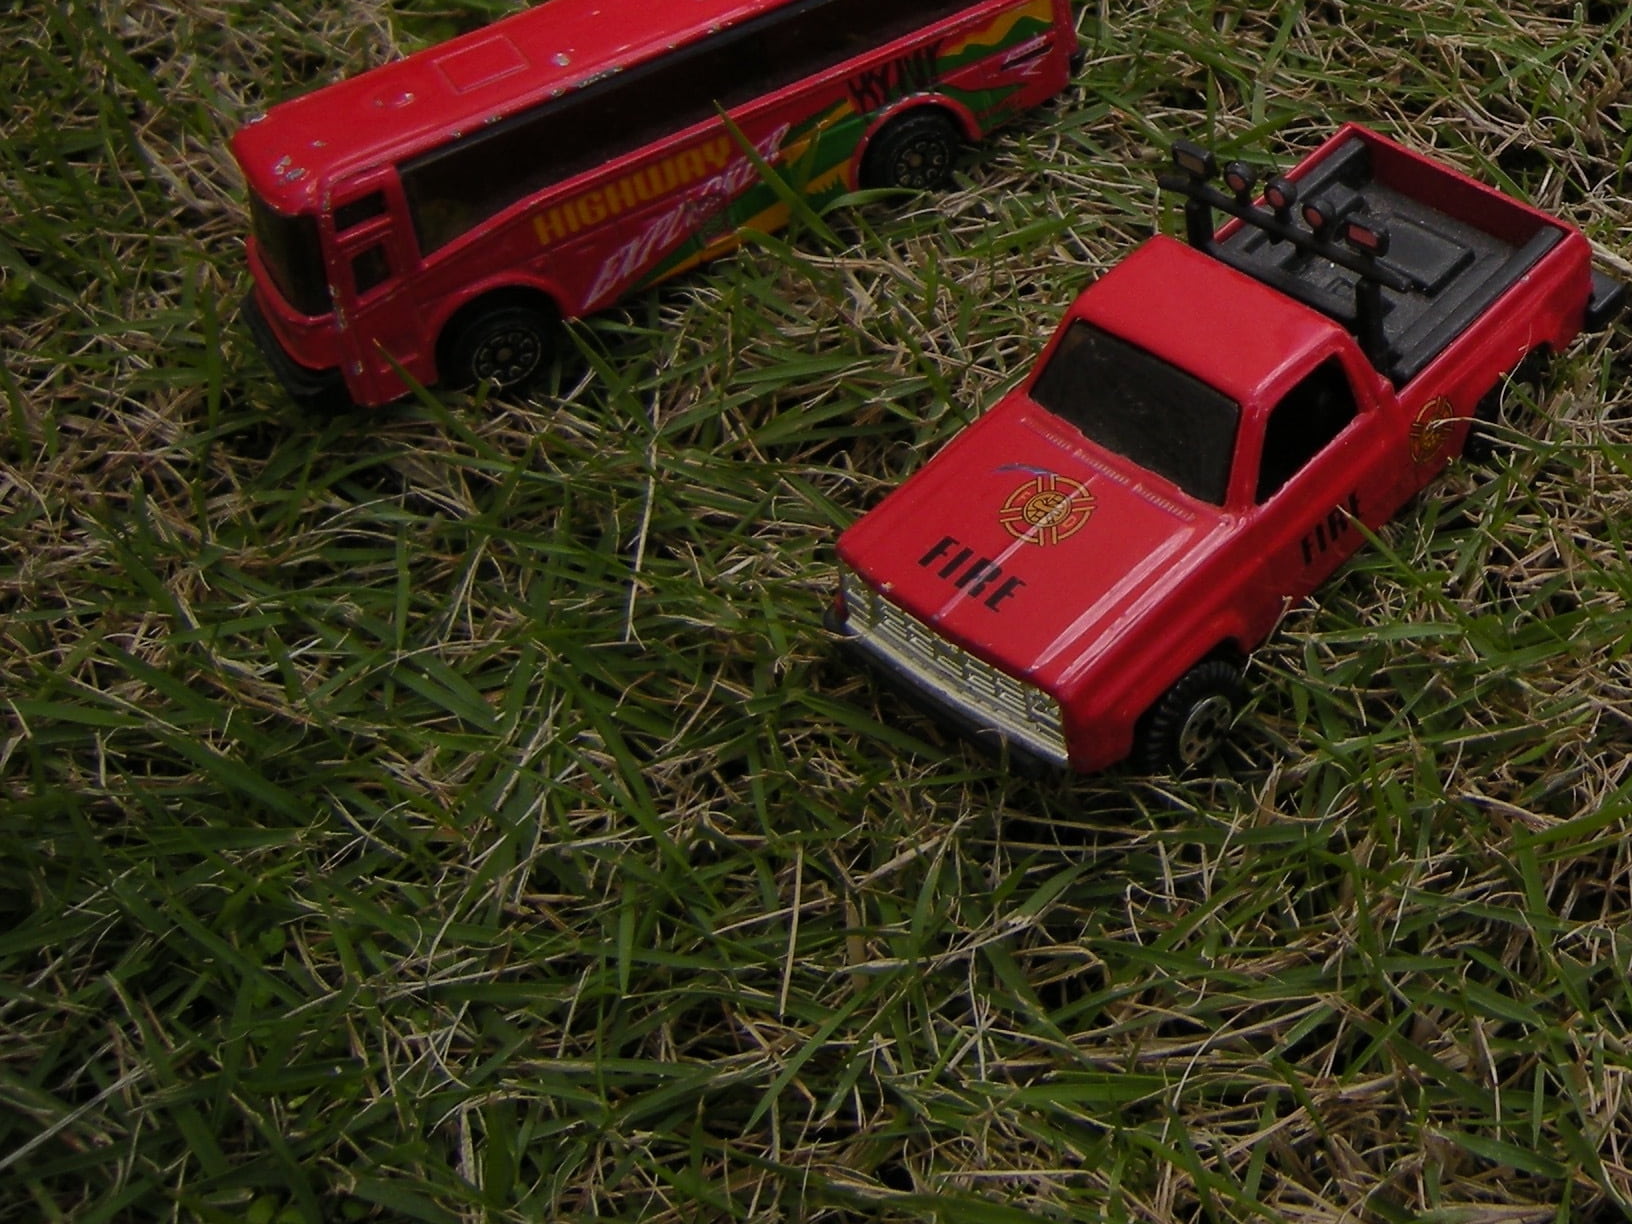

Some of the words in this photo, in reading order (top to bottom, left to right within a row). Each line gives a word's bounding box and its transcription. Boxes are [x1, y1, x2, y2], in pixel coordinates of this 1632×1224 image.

[532, 135, 732, 247] HIGHWAY
[1301, 489, 1363, 566] FIRE
[917, 535, 1027, 613] FIRE
